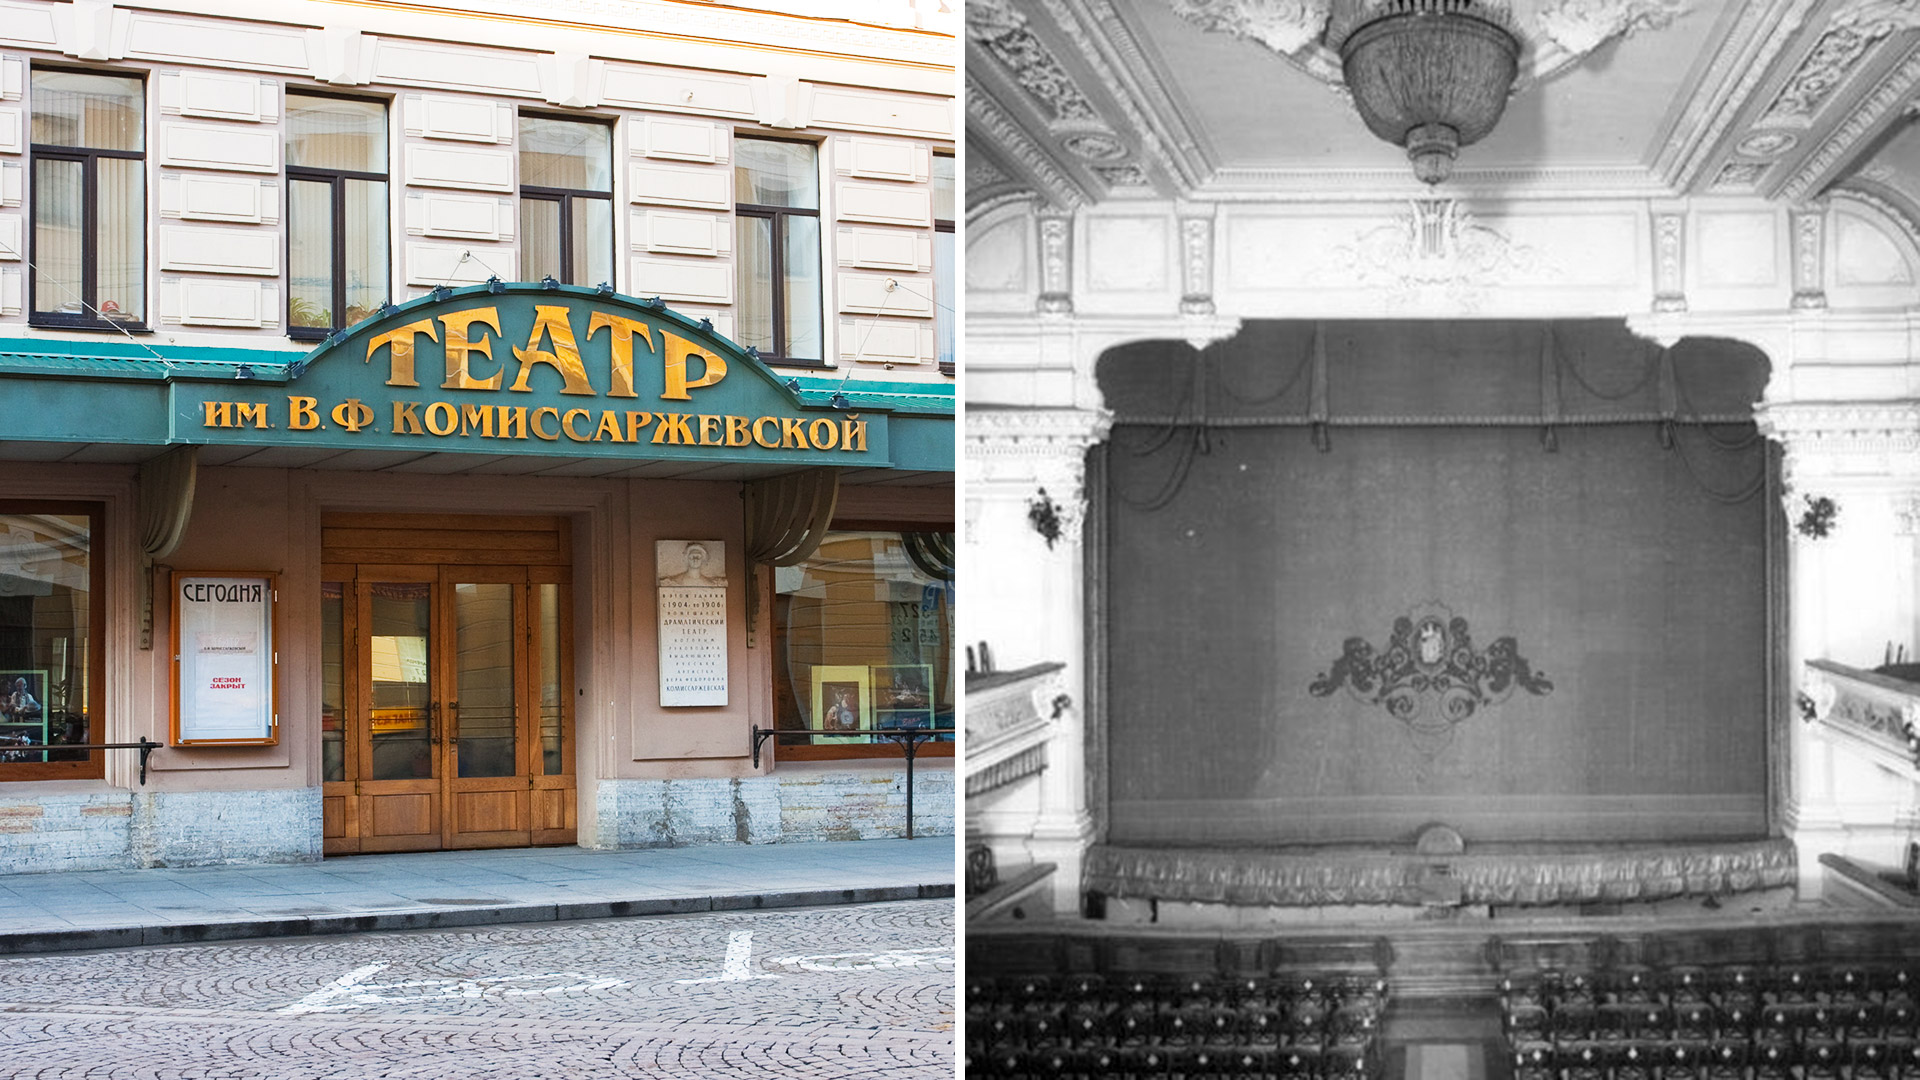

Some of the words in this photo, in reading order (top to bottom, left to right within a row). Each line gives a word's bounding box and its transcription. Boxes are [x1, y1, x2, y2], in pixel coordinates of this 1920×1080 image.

[365, 305, 728, 400] ТЕАТР
[391, 400, 868, 452] КОМИССАРЖЕВСКОЙ
[183, 584, 262, 603] СЕГОДНЯ
